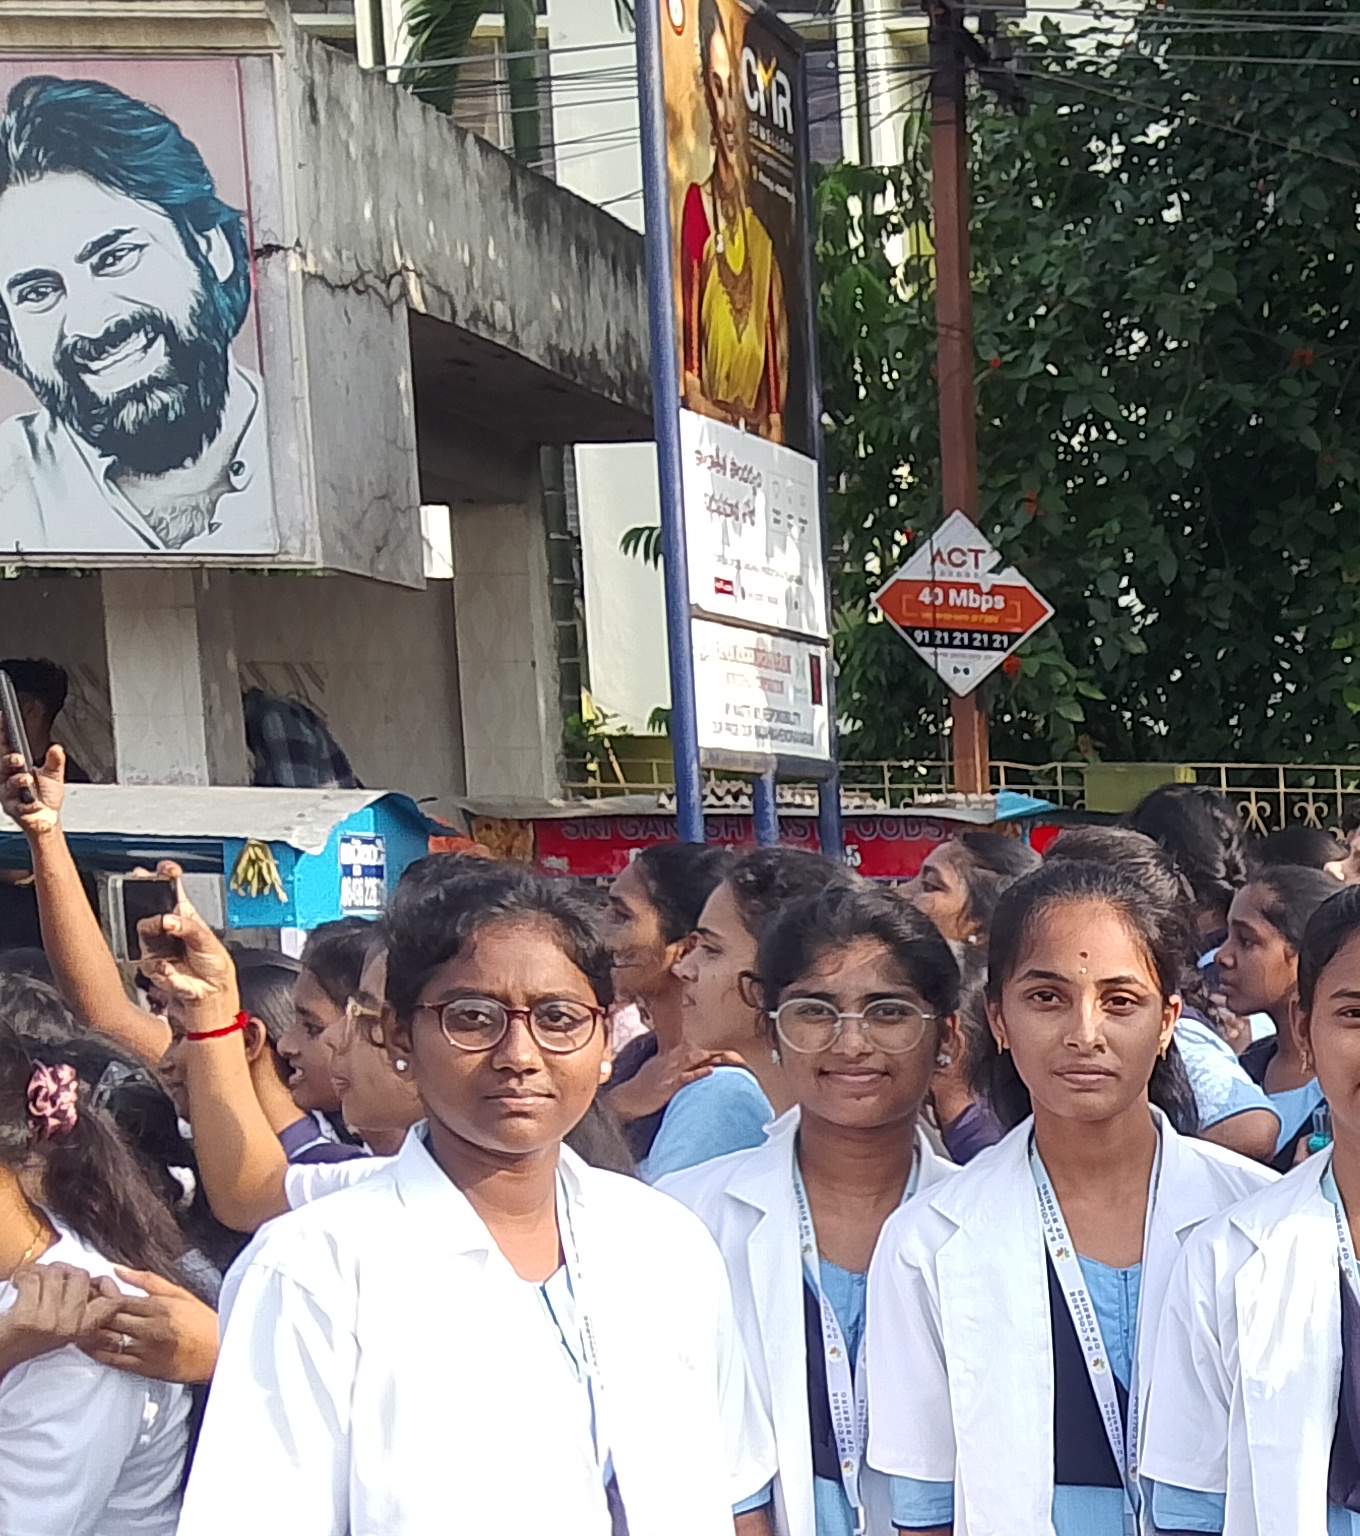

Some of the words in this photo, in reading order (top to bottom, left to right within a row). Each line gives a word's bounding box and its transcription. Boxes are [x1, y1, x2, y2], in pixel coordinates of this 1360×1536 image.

[932, 547, 987, 569] ACT
[918, 587, 944, 605] 40
[948, 588, 1006, 612] Mbps
[914, 629, 929, 644] 91
[953, 632, 969, 646] 21
[972, 633, 989, 647] 21
[992, 634, 1008, 648] 21
[562, 818, 612, 840] SRI
[617, 817, 744, 841] GANSH
